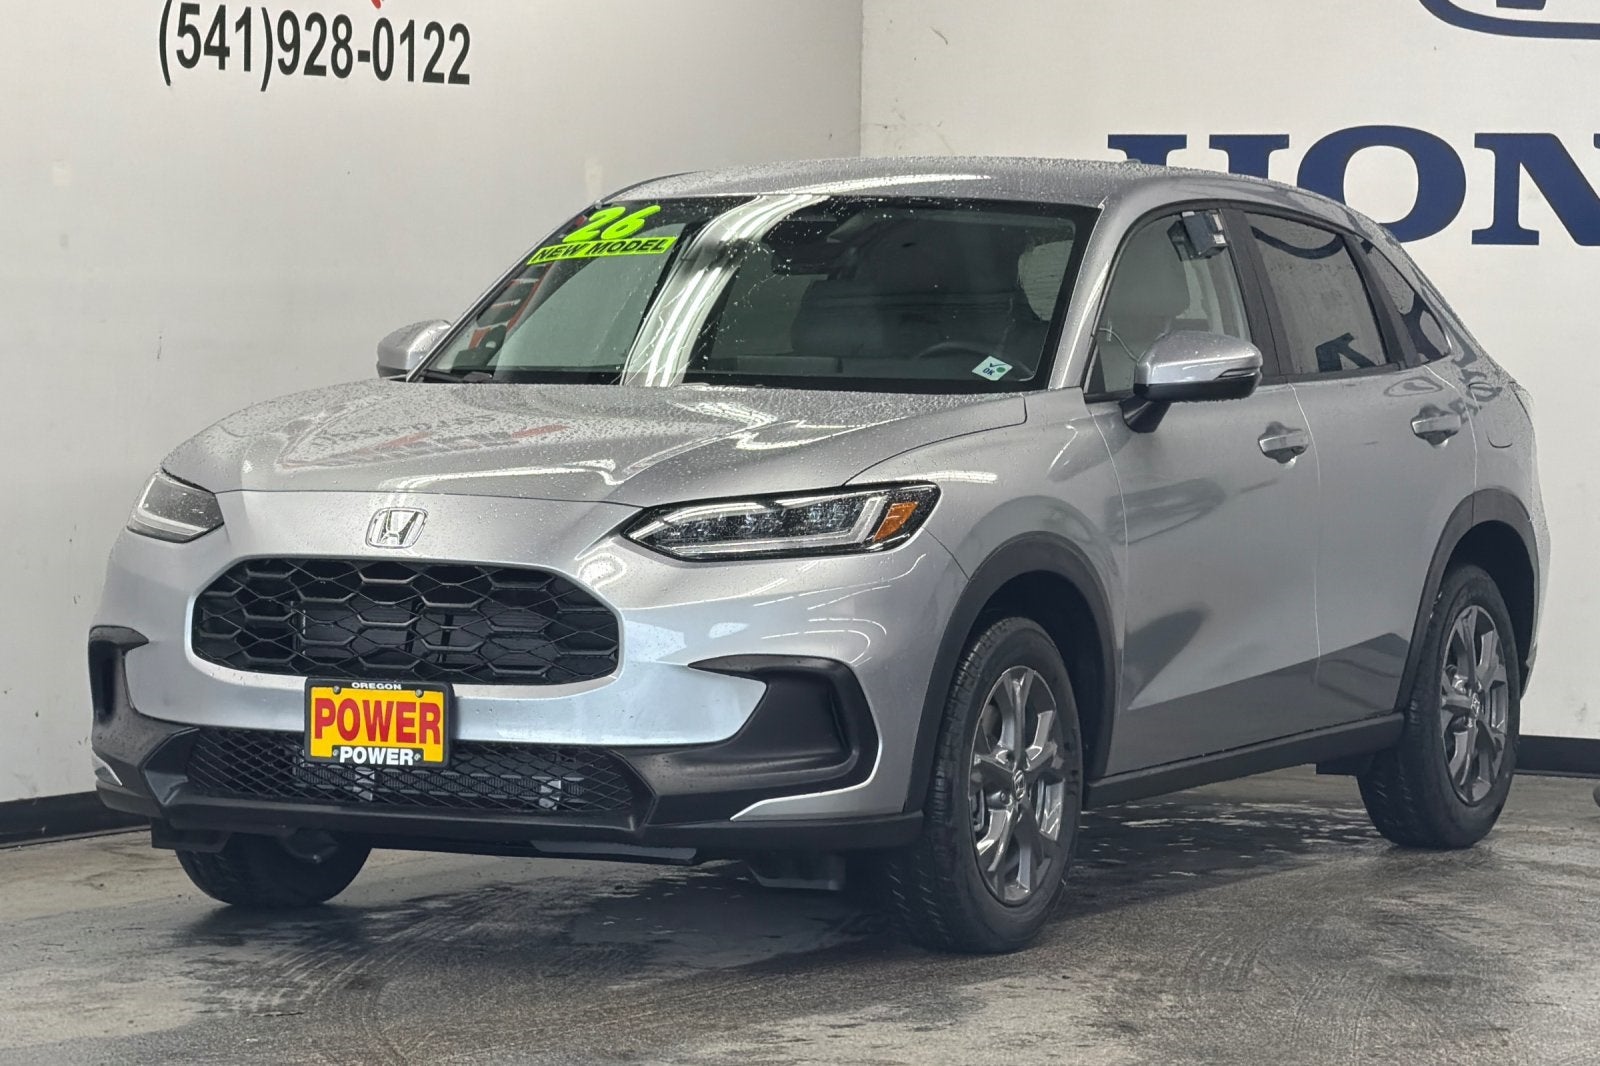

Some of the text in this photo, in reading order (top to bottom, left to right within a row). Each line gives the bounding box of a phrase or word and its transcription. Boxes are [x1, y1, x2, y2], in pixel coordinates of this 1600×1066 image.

[159, 0, 471, 92] (541)928-0122
[562, 205, 661, 243] 26
[535, 239, 668, 260] NEW MODEL
[351, 681, 402, 691] OREGON
[314, 697, 441, 745] POWER
[339, 746, 414, 766] POWER
